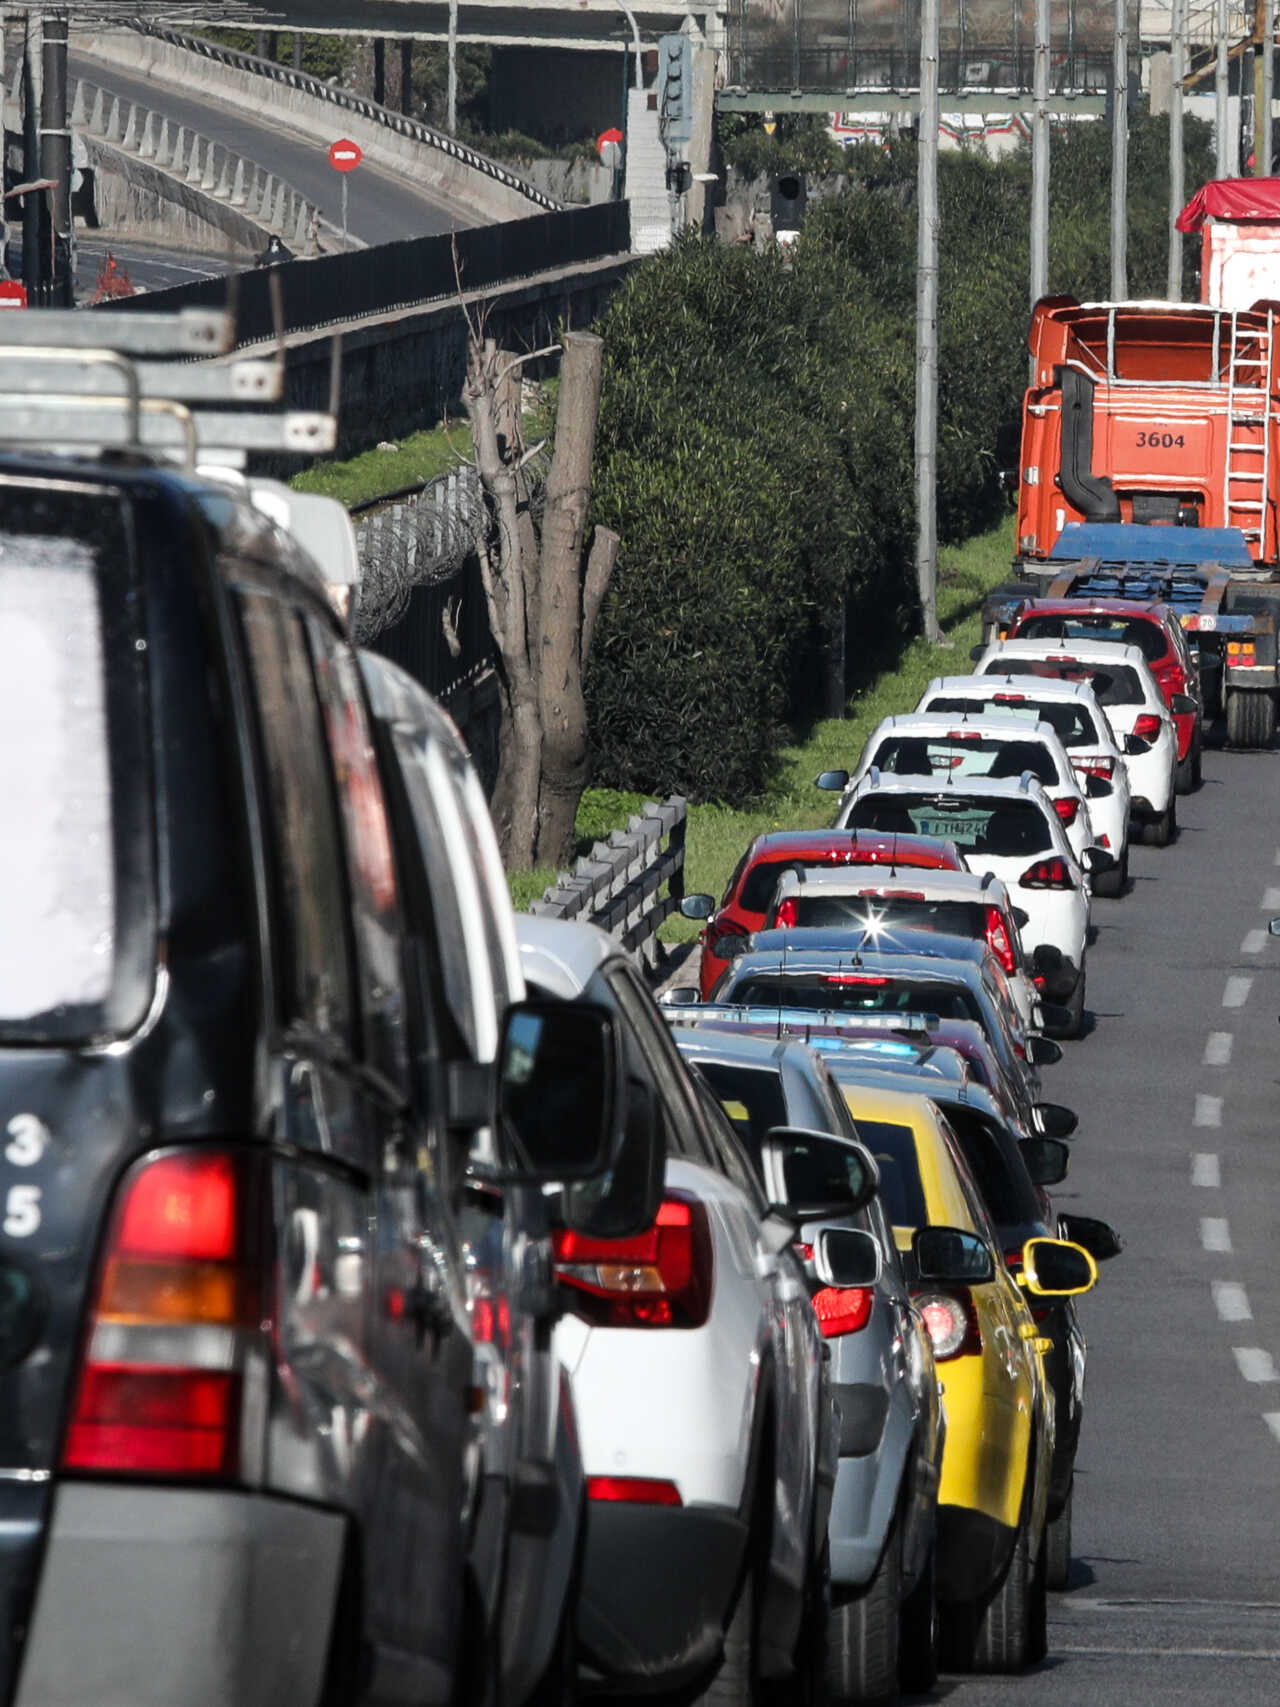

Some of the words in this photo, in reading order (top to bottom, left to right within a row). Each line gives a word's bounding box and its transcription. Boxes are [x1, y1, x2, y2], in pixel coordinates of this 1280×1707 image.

[1136, 431, 1185, 448] 3604
[5, 1112, 44, 1167] 3
[3, 1184, 42, 1238] 5
